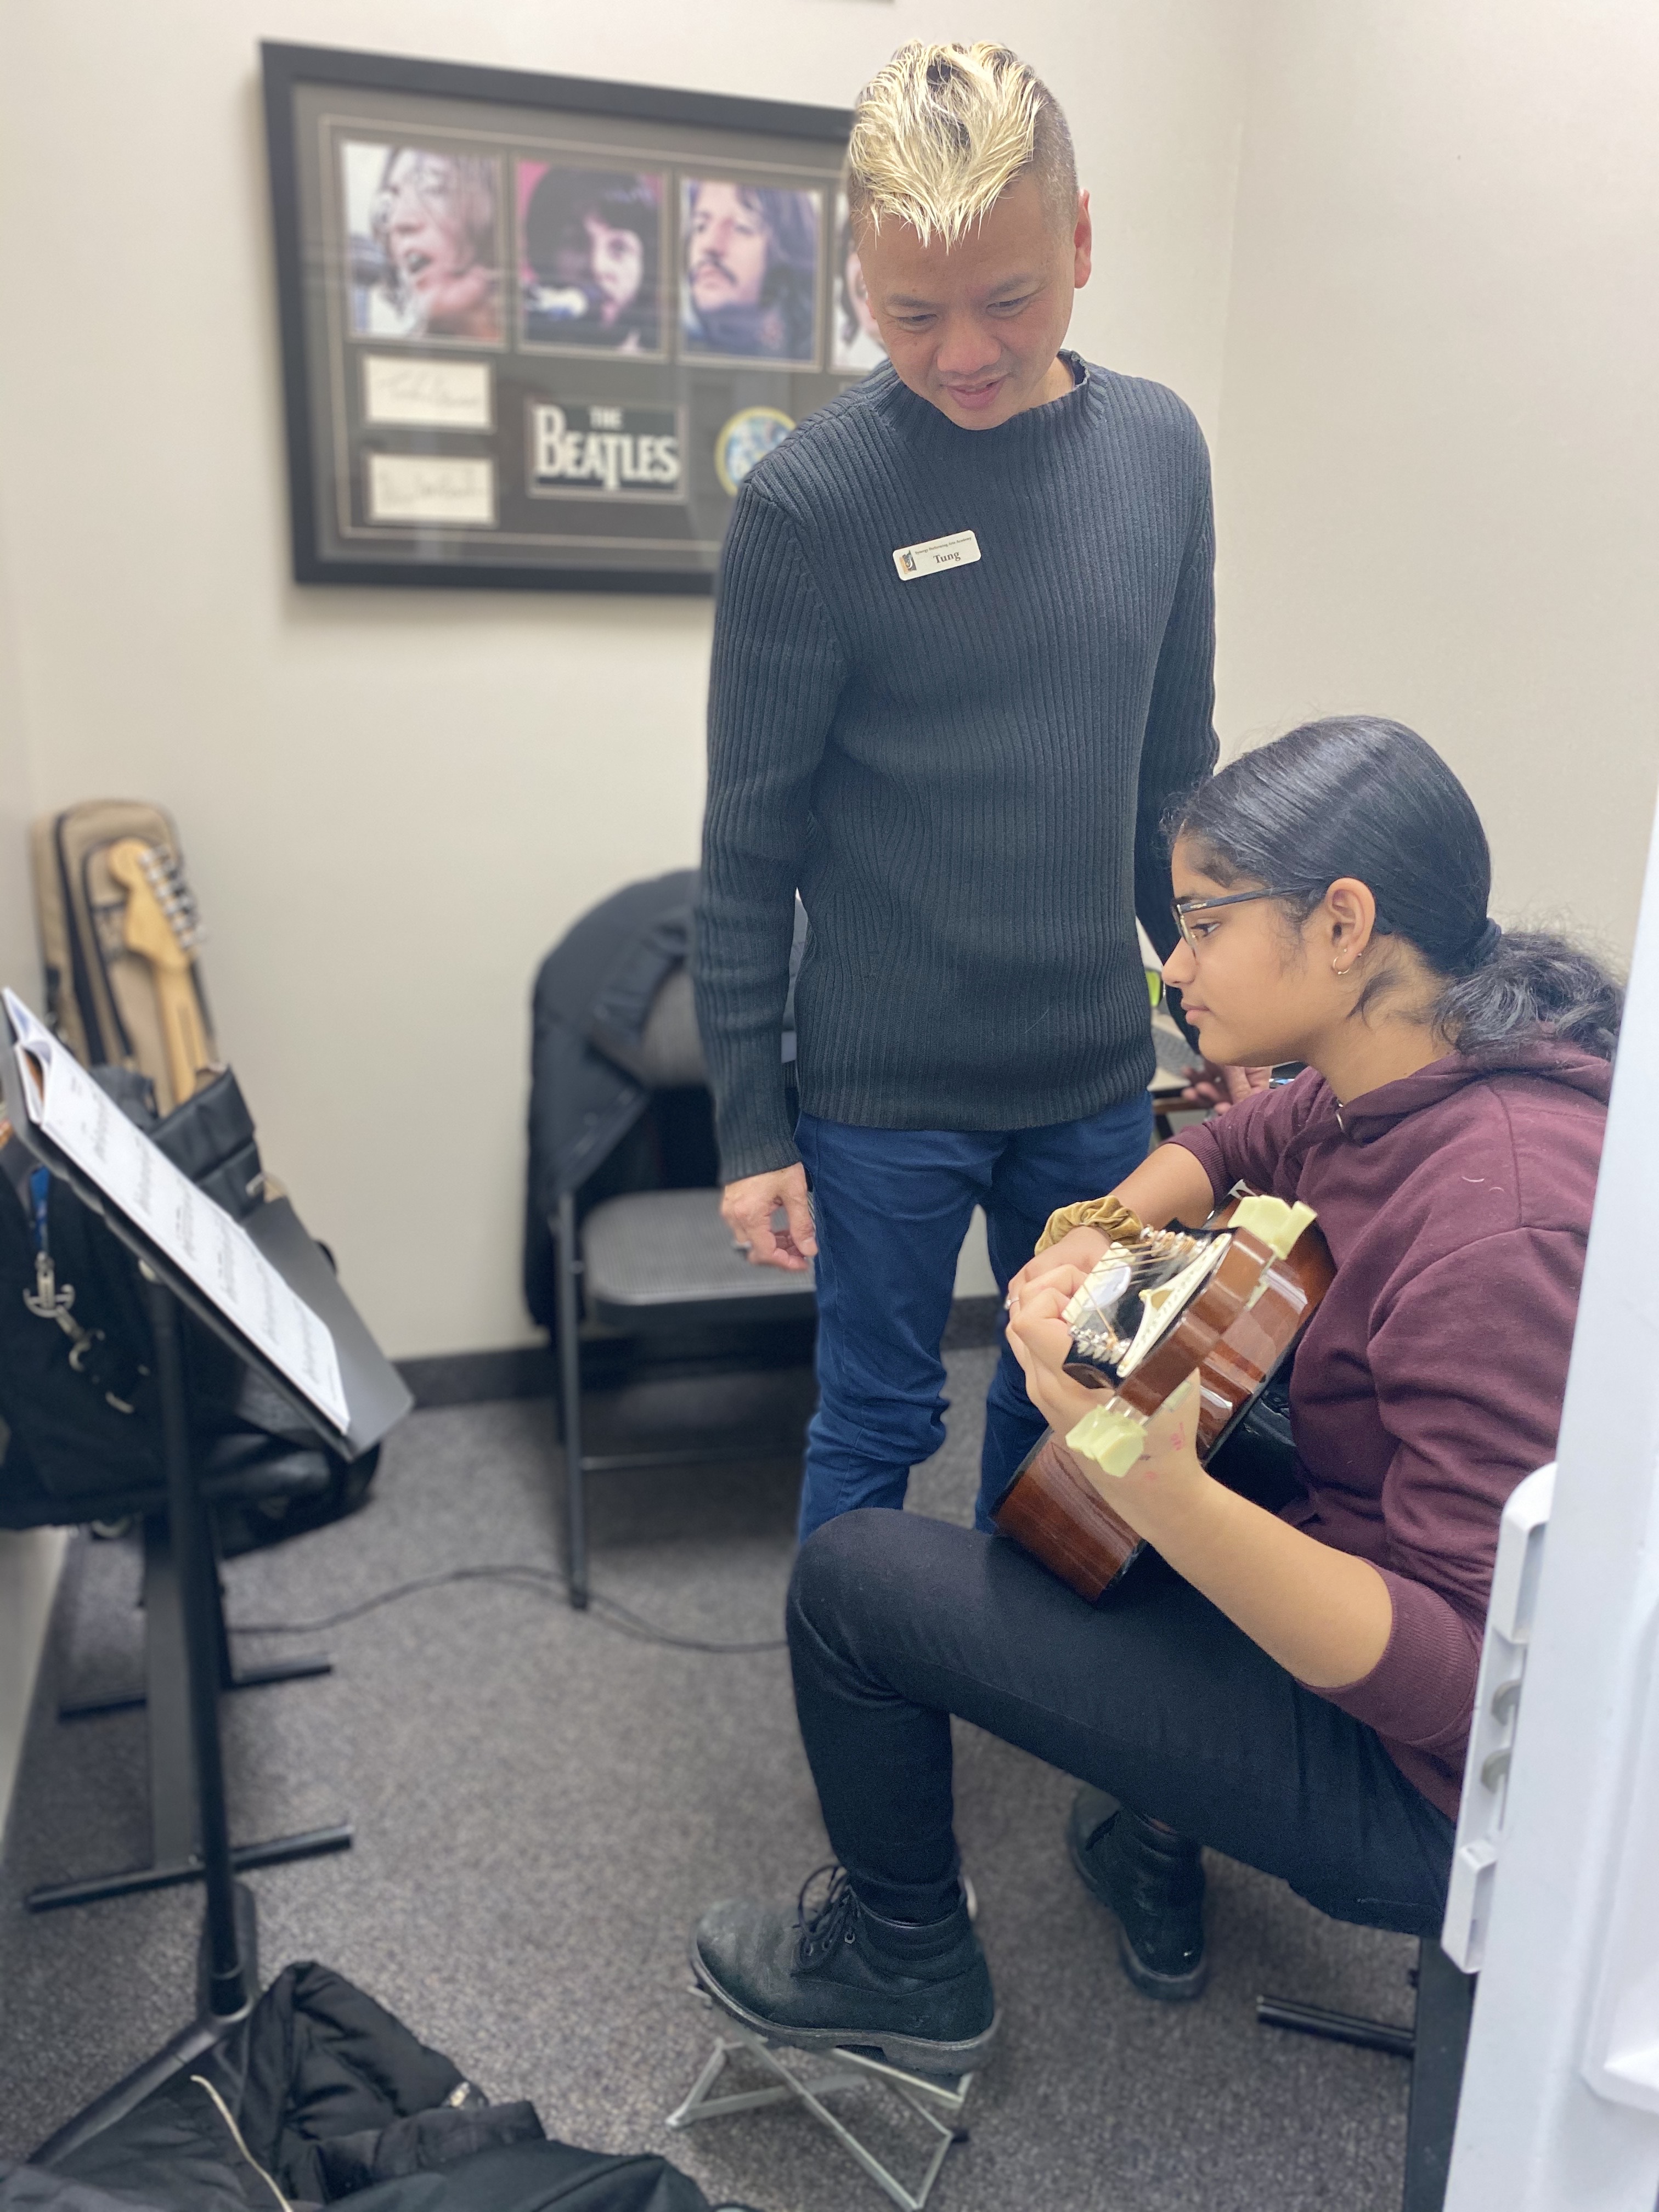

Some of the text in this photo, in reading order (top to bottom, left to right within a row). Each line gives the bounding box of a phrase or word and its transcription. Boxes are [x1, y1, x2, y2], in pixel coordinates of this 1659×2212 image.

[589, 407, 622, 430] THE
[535, 405, 680, 492] BEATLES
[933, 552, 961, 563] Tung
